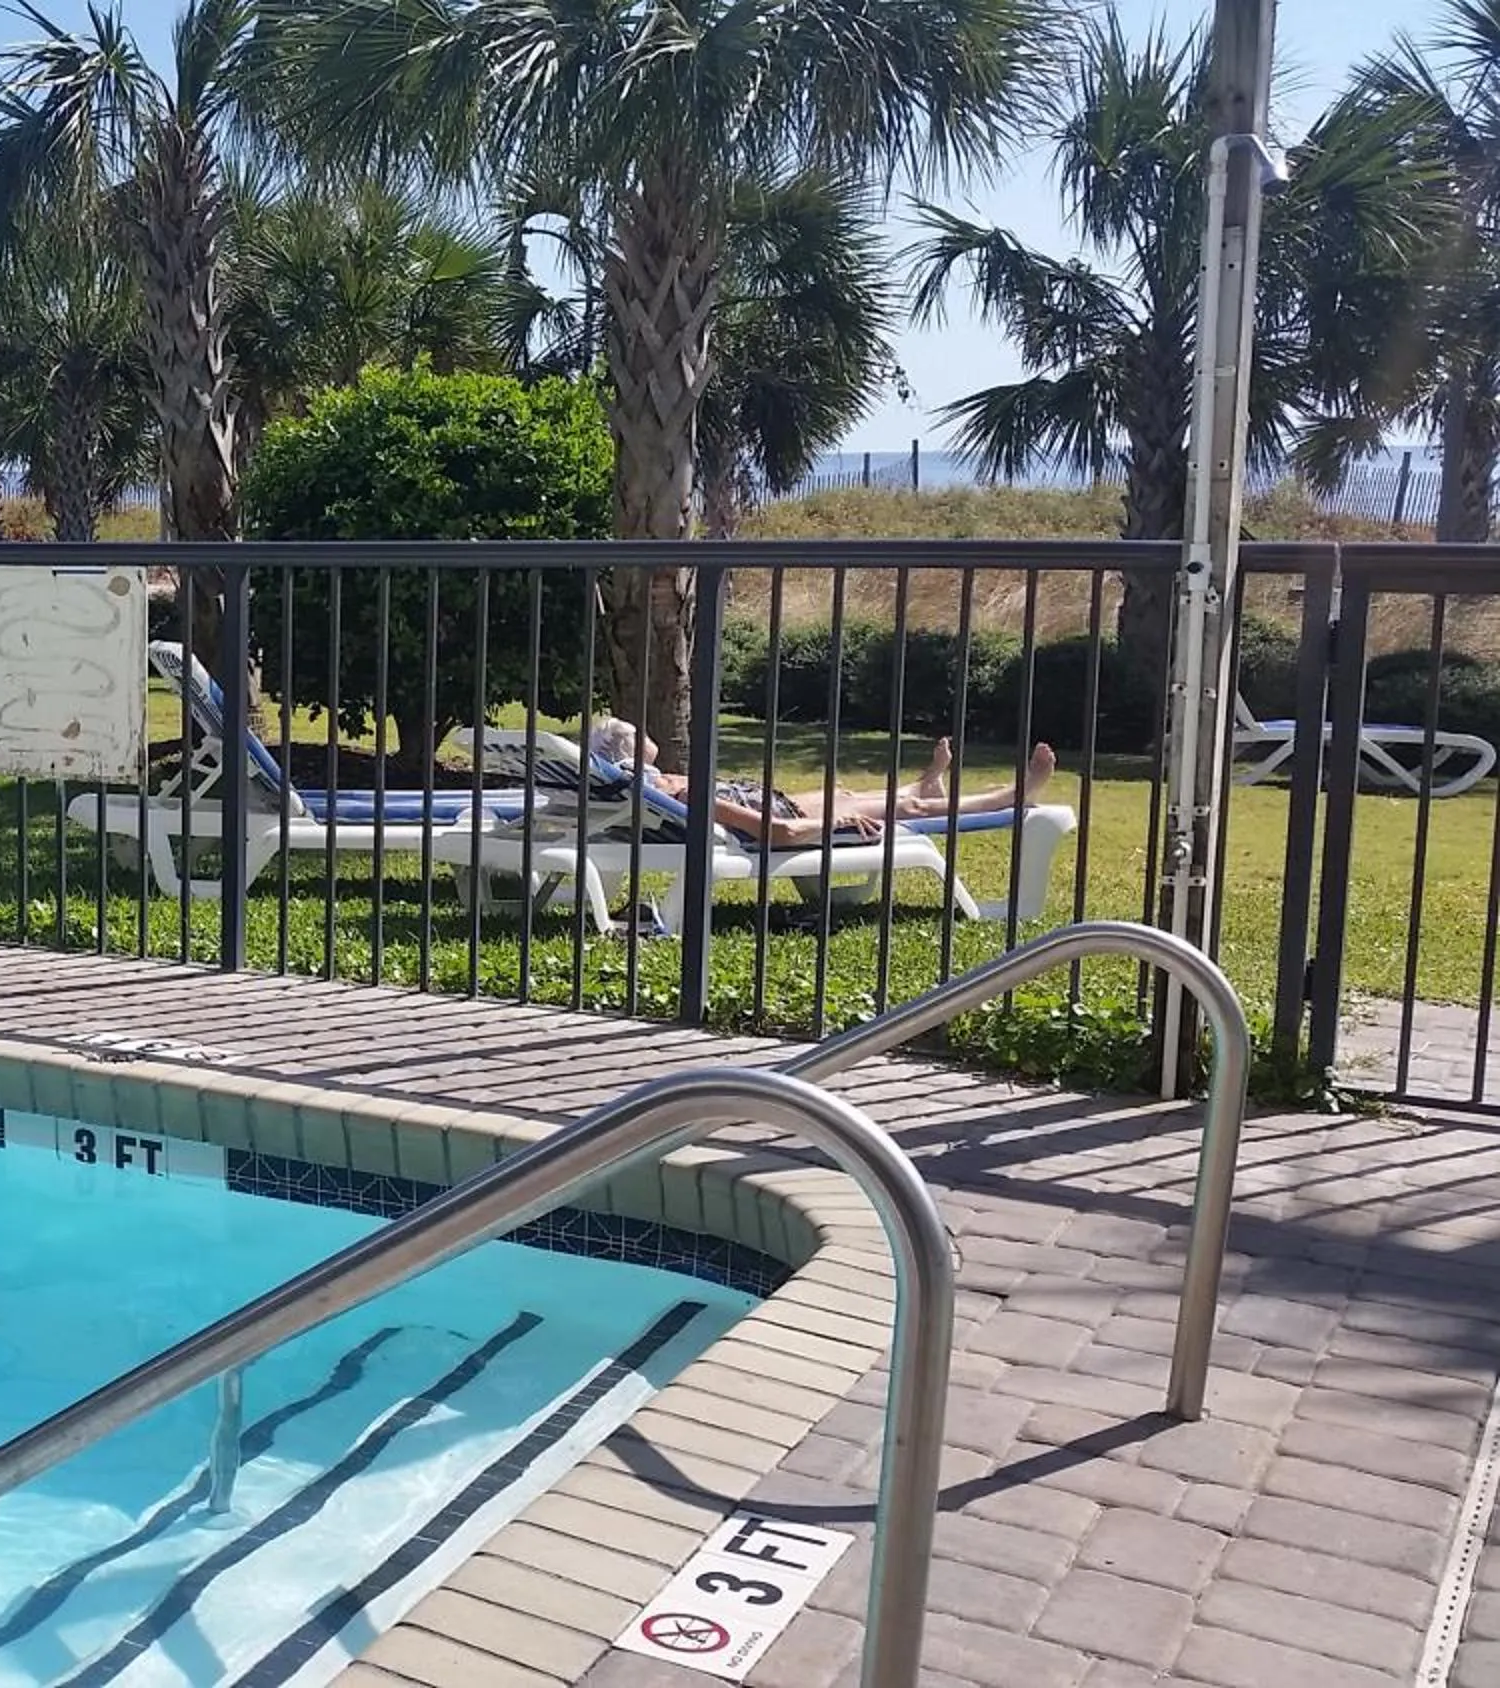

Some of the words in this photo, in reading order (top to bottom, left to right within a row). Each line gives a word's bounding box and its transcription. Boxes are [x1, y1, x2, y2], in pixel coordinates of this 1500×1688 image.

[73, 1127, 97, 1164] 3
[114, 1134, 163, 1176] FT
[723, 1517, 829, 1571] FT
[695, 1571, 784, 1606] 3
